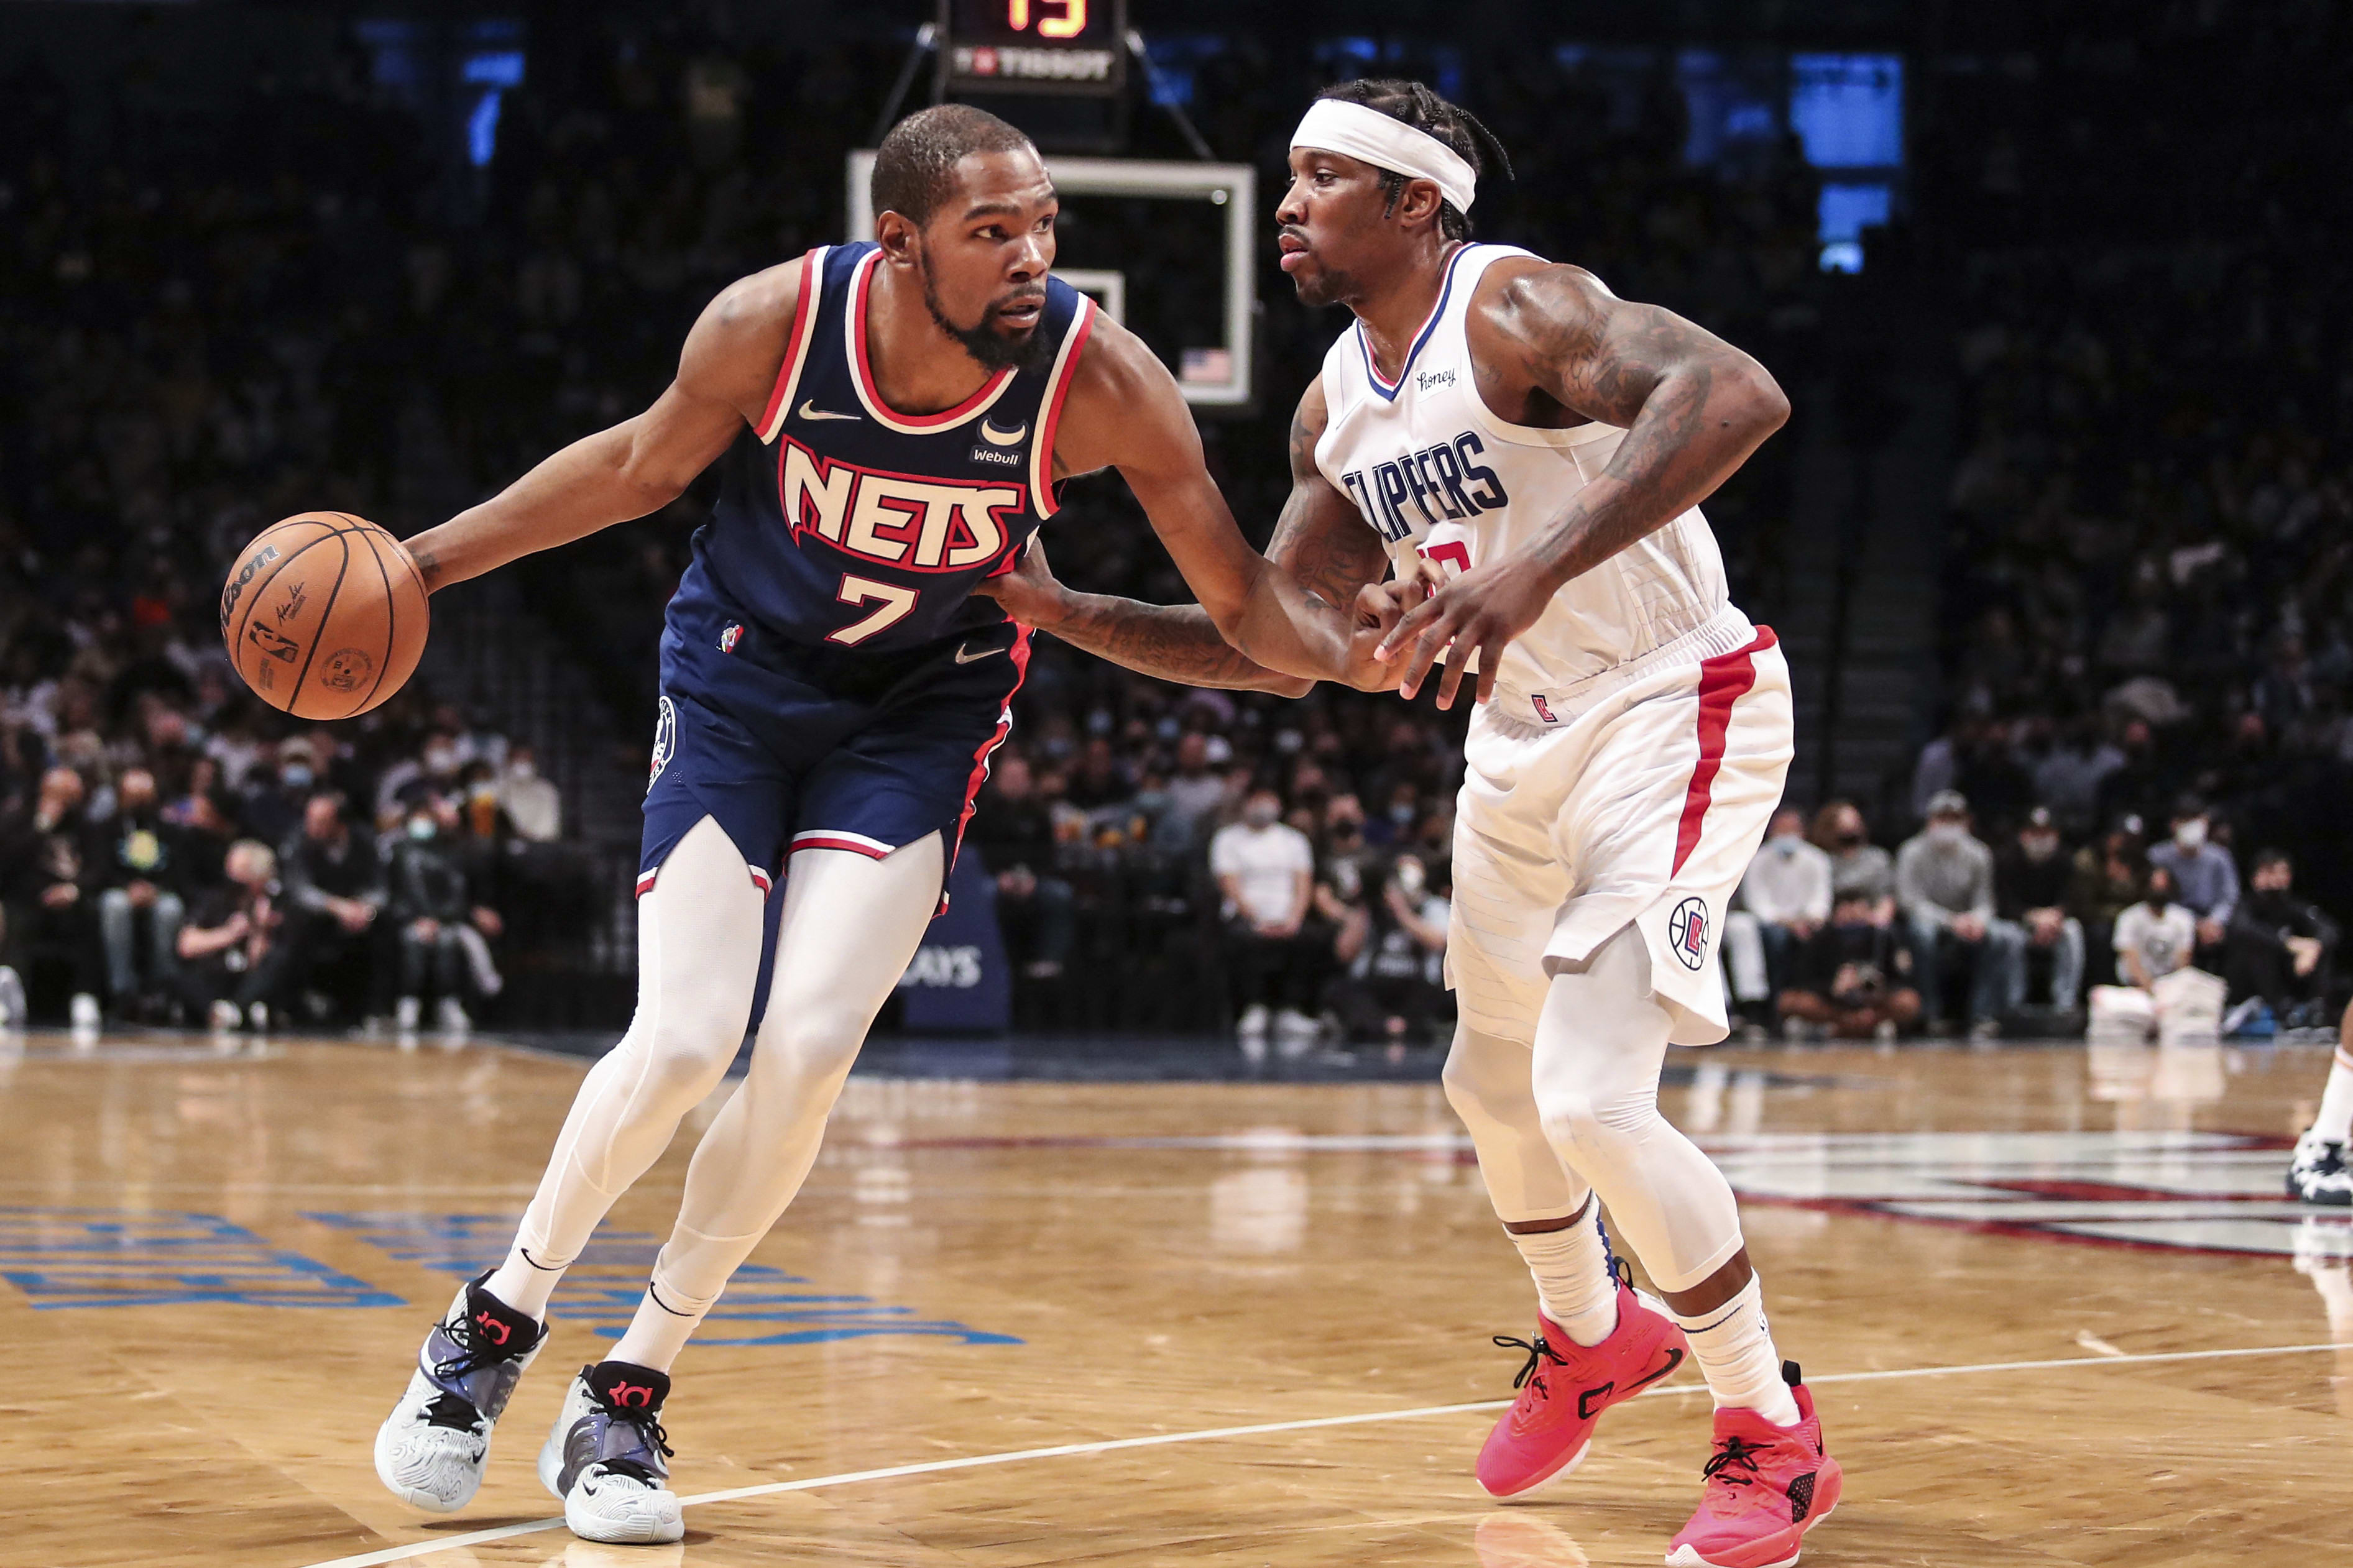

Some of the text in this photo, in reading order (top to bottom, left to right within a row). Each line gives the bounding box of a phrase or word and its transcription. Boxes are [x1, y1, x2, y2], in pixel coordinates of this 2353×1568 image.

[1417, 368, 1456, 392] honey
[974, 449, 1018, 465] Webull
[779, 434, 1026, 574] NETS
[824, 572, 920, 648] 7
